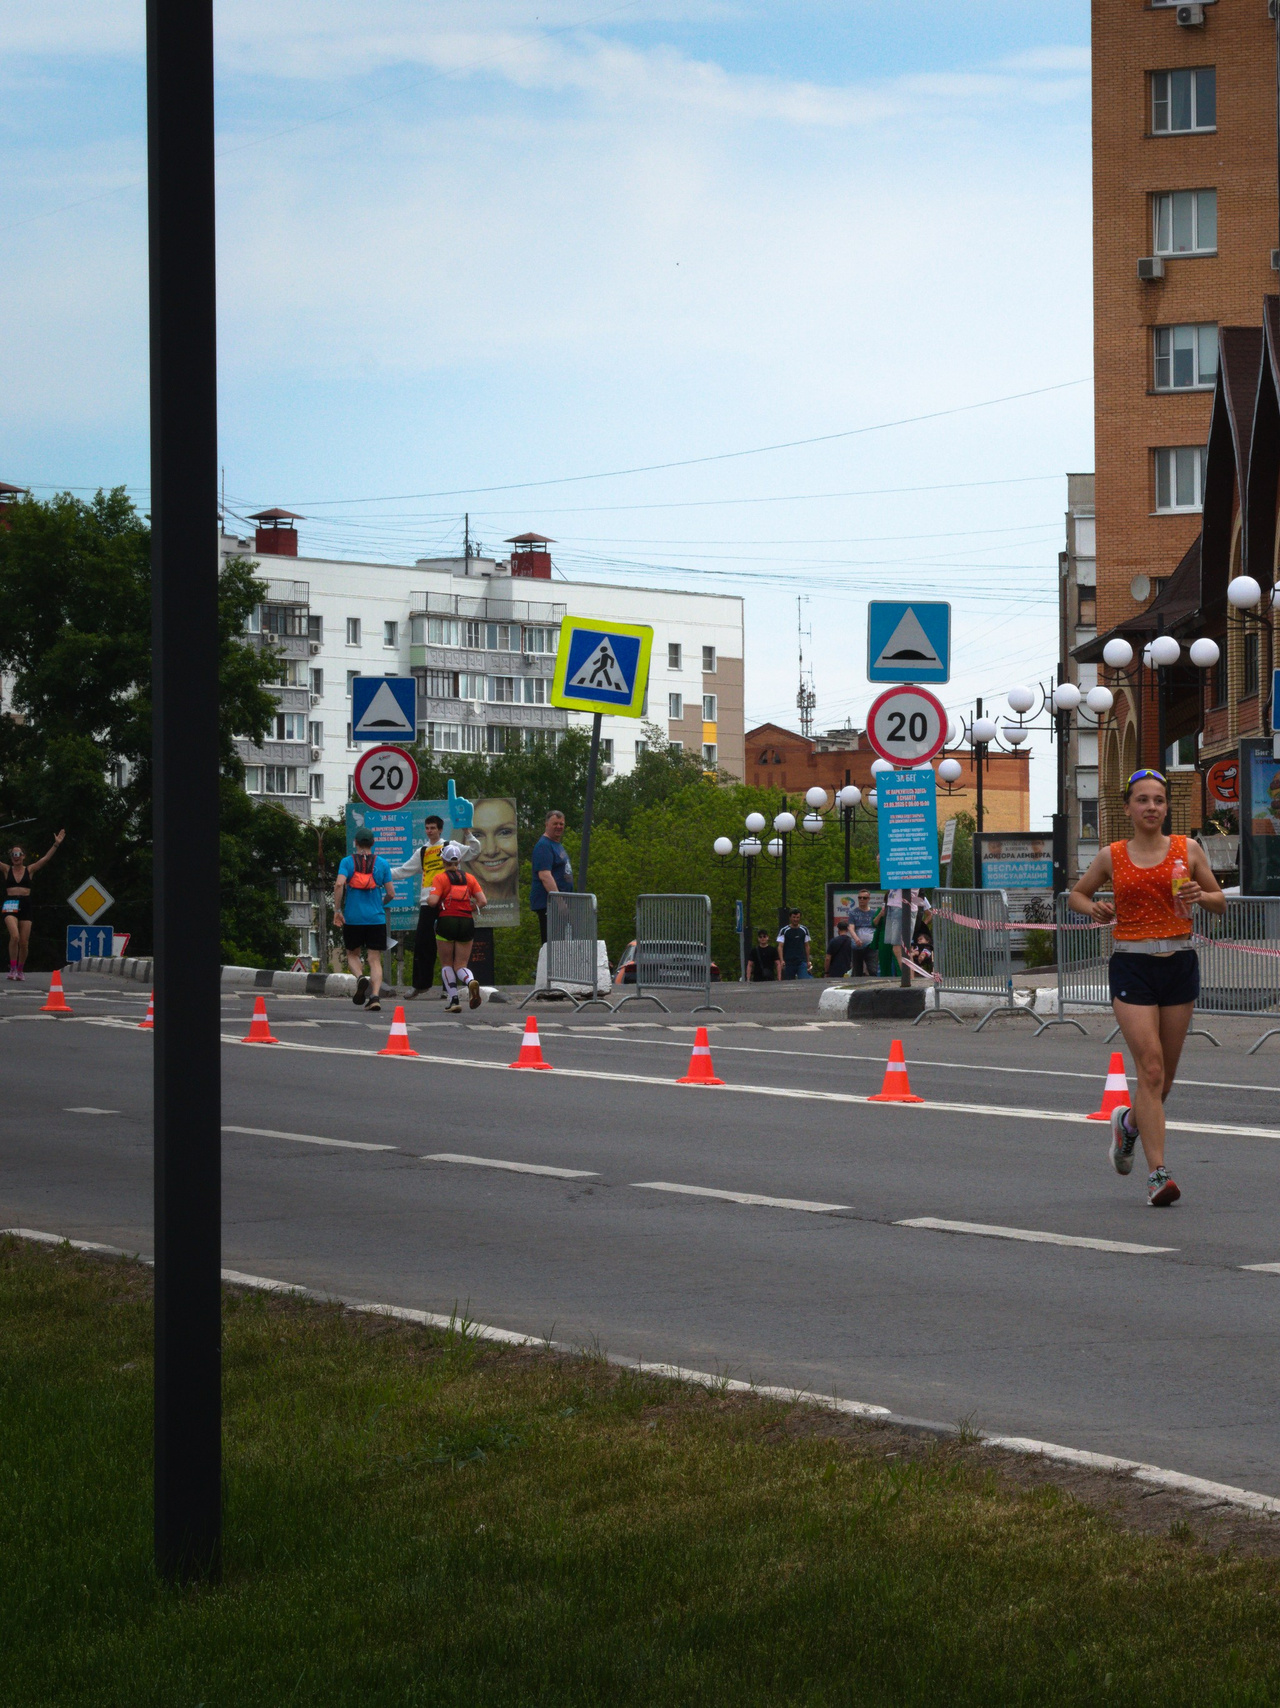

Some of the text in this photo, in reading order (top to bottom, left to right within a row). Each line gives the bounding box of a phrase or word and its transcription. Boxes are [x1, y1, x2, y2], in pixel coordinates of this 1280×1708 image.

[887, 711, 928, 742] 20
[369, 764, 404, 791] 20
[984, 852, 1015, 860] ДОКТОРА
[988, 864, 1048, 872] БЕСПЛАТНАЯ
[988, 872, 1048, 880] КОНСУЛЬТАЦИЯ
